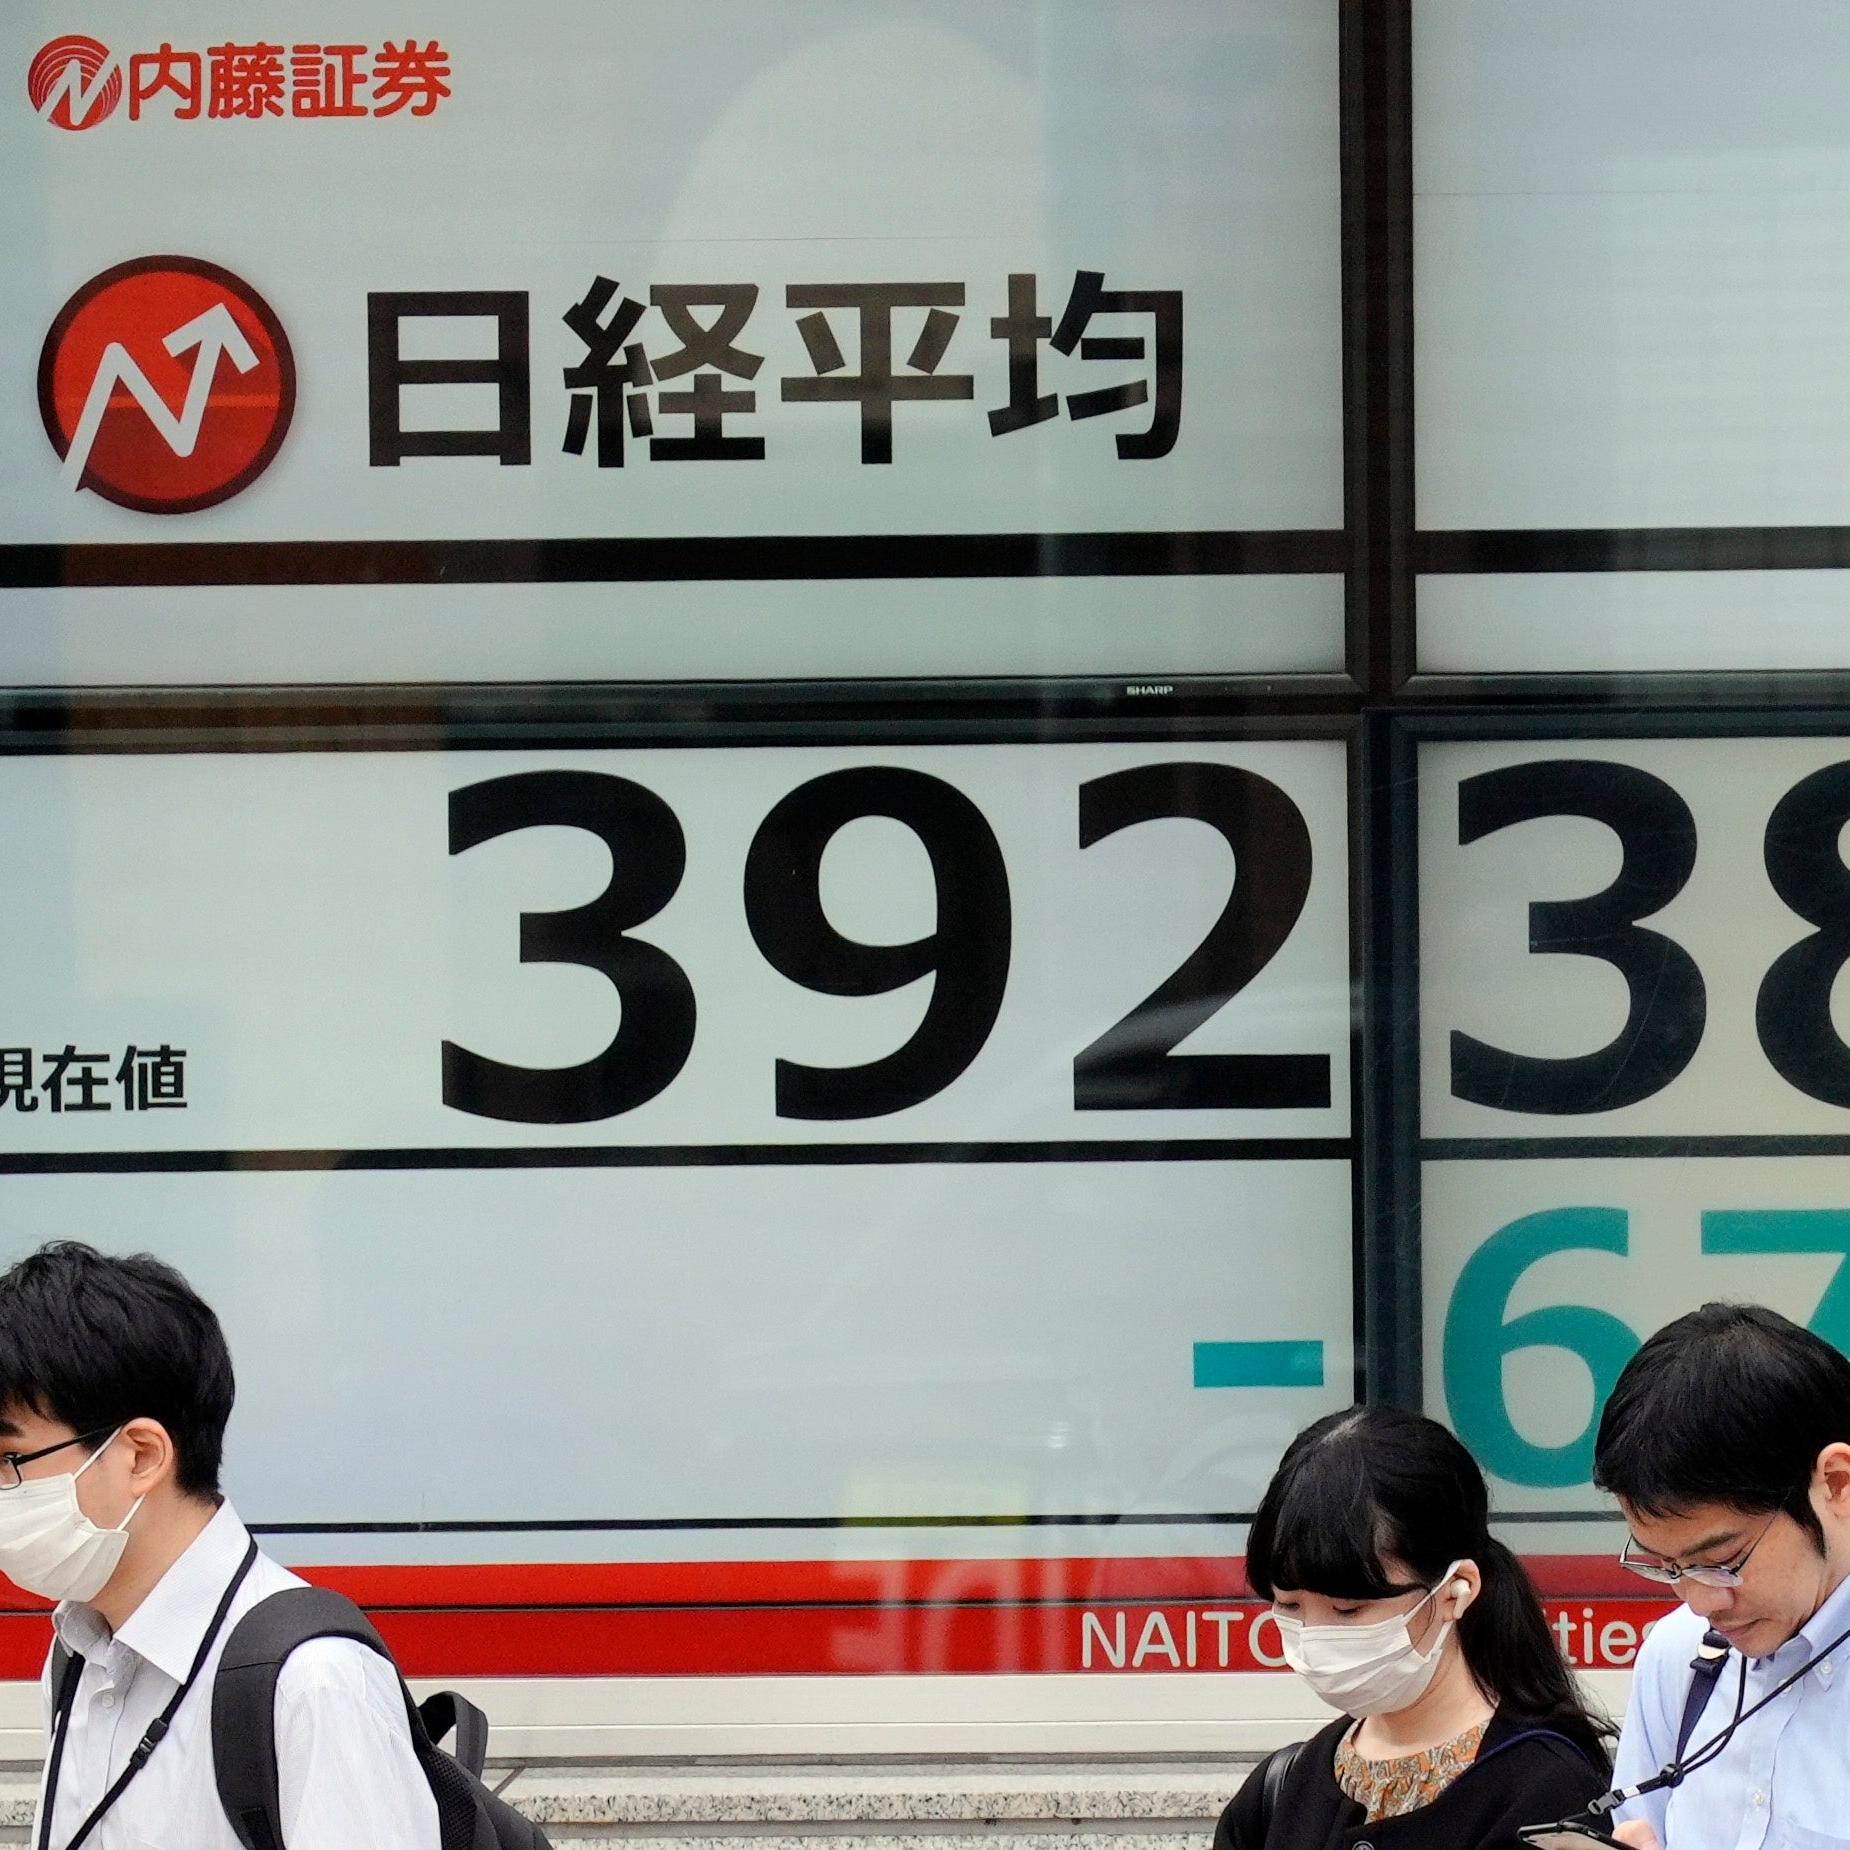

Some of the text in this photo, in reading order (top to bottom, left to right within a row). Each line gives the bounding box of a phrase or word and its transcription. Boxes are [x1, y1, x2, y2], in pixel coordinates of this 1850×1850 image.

[127, 40, 452, 120] 内藤証券
[365, 270, 1185, 470] 日経平均
[1126, 684, 1174, 696] SHARP
